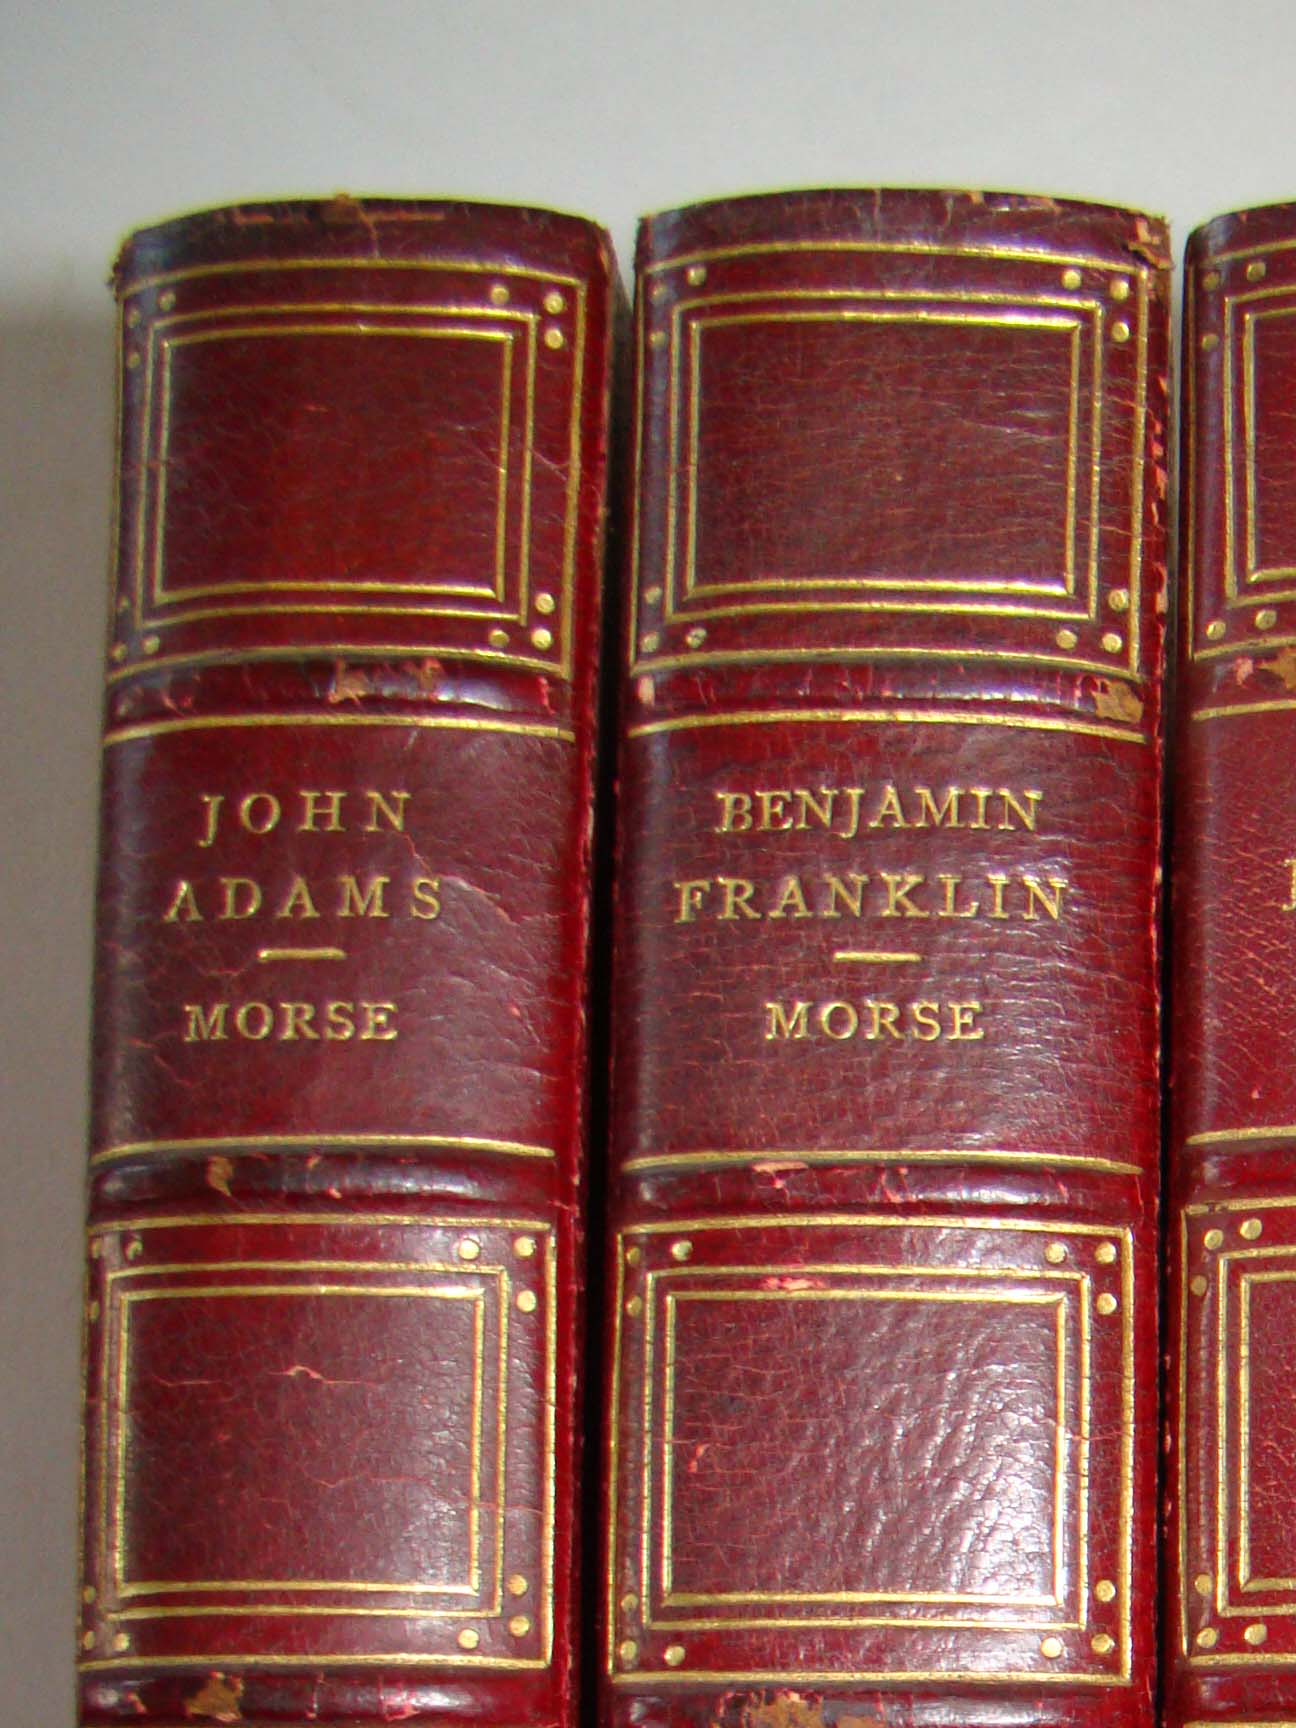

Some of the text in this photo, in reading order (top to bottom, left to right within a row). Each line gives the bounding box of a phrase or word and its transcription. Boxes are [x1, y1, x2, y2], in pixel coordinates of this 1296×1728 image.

[198, 791, 412, 847] JOHN
[714, 785, 1043, 838] BENJAMIN
[162, 875, 442, 922] ADAMS
[674, 873, 1069, 923] FRANKLIN
[183, 1002, 399, 1041] MORSE
[765, 1000, 985, 1040] MORSE
